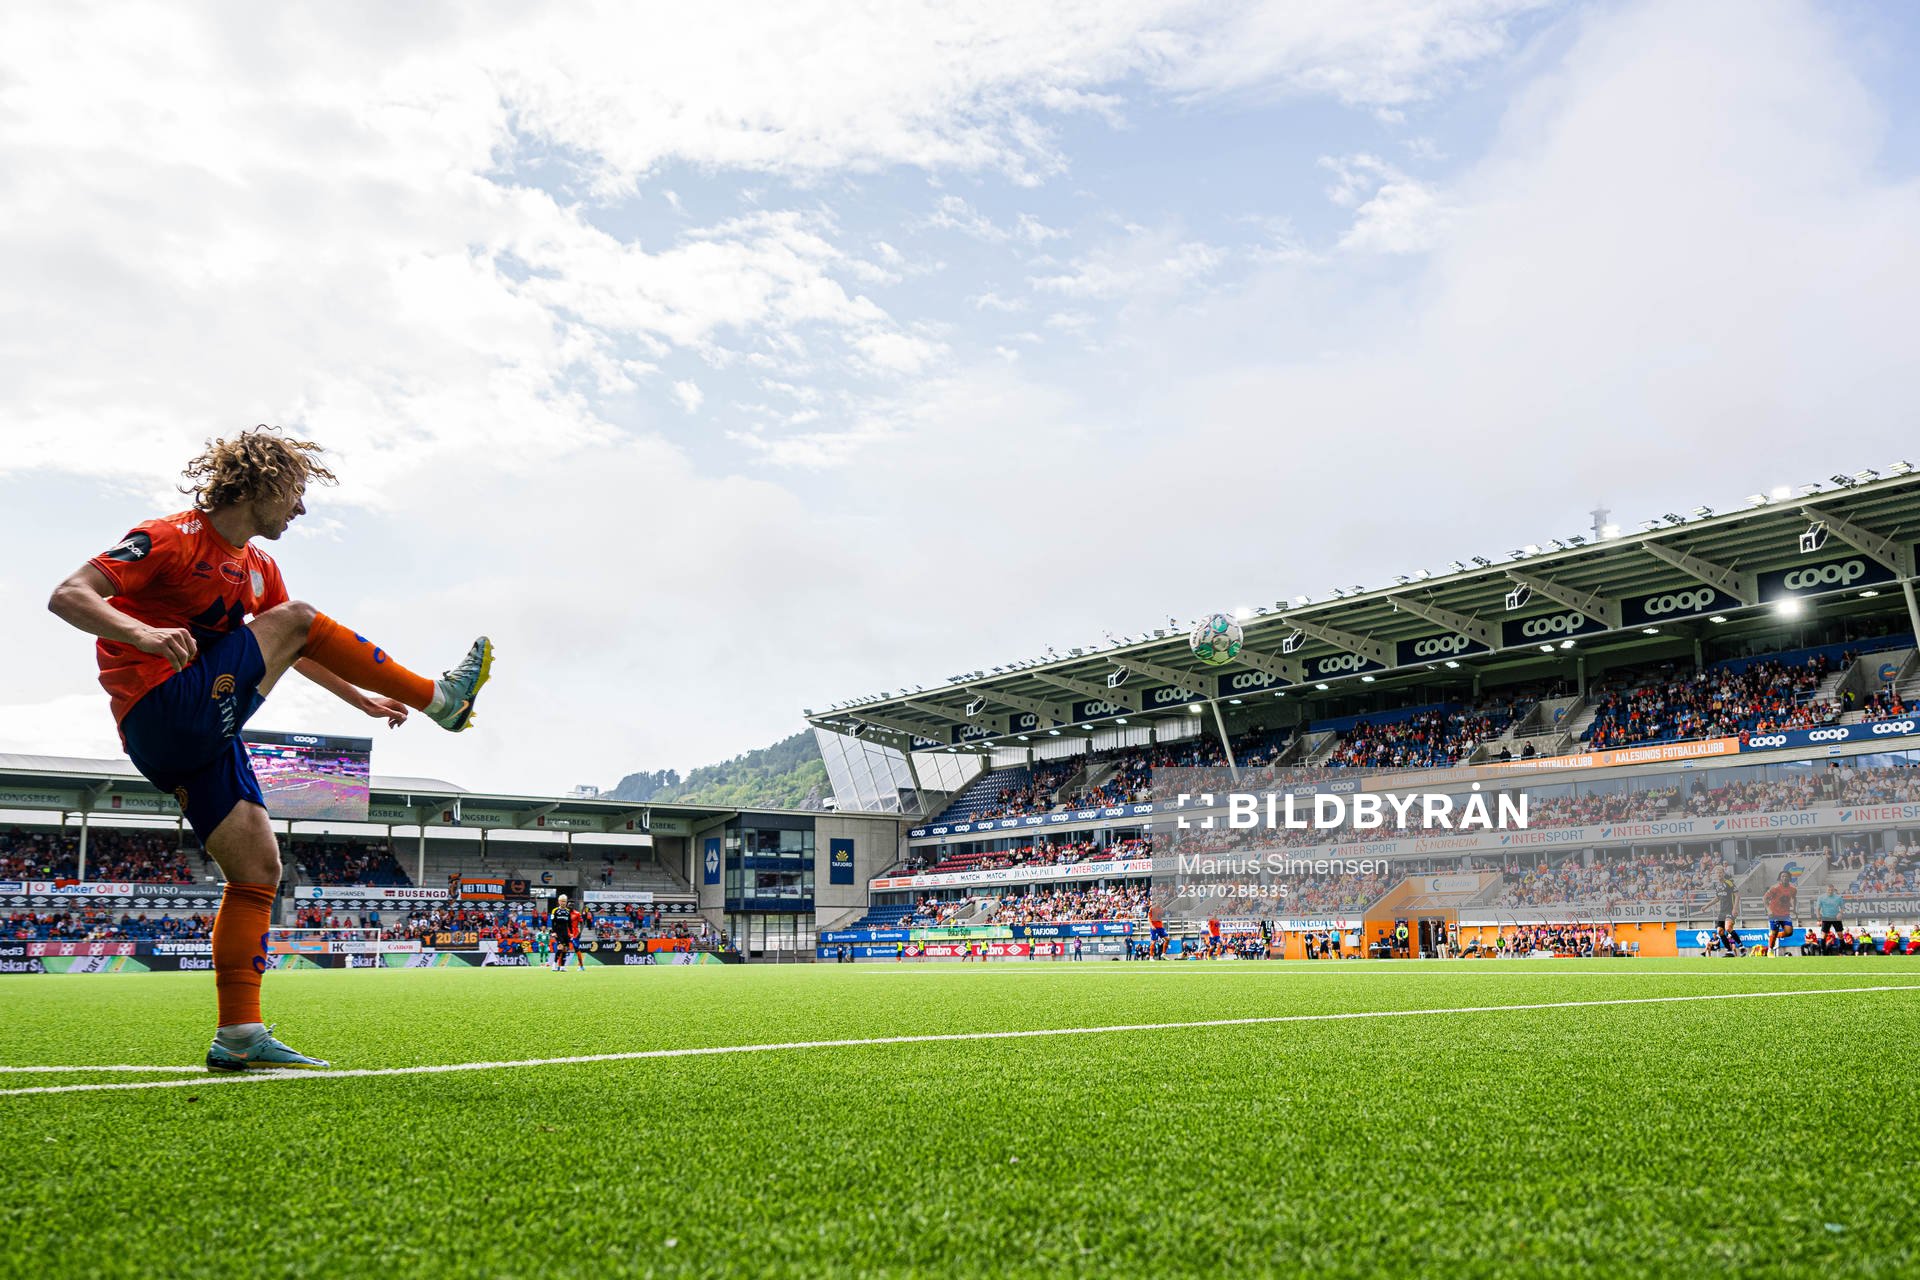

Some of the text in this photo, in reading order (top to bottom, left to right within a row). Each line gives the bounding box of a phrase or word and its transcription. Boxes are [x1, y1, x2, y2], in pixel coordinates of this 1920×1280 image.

[1784, 560, 1866, 590] coop
[1644, 588, 1716, 616] coop
[1522, 612, 1585, 637] coop
[1414, 633, 1470, 657] coop
[1318, 653, 1368, 674] coop
[1232, 671, 1277, 689] coop
[1155, 685, 1194, 703] coop
[1084, 701, 1120, 717] coop
[1872, 720, 1915, 734] coop
[1808, 727, 1849, 741] coop
[293, 735, 318, 745] coop
[1749, 734, 1787, 748] coop
[1615, 742, 1725, 763] AALESUNDS FOTBALLKLUBB
[1294, 785, 1318, 796] coop
[1331, 782, 1355, 792] coop
[1105, 807, 1124, 817] coop
[1134, 803, 1153, 814] coop
[460, 814, 501, 823] ONGSBERG
[1026, 816, 1043, 825] coop
[1051, 813, 1069, 823] coop
[1077, 810, 1096, 820] coop
[977, 821, 994, 830] coop
[1001, 819, 1018, 828] coop
[1727, 812, 1818, 830] INTERSPORT
[911, 829, 926, 838] coop
[932, 826, 948, 835] coop
[955, 823, 970, 833] coop
[1613, 821, 1695, 837] INTERSPORT
[1511, 829, 1585, 844] INTERSPORT
[1338, 843, 1397, 856] INTERSPORT
[1071, 863, 1114, 875] INTERSPORT
[961, 873, 980, 881] MATCH
[987, 872, 1007, 880] MATCH
[136, 886, 178, 895] ADVISO
[398, 890, 448, 898] BUSENGD
[1625, 906, 1646, 916] SLIP
[1648, 905, 1662, 916] AS
[1290, 918, 1335, 928] RINGDAL
[1032, 927, 1059, 936] TAFJORD
[926, 946, 952, 956] umbro
